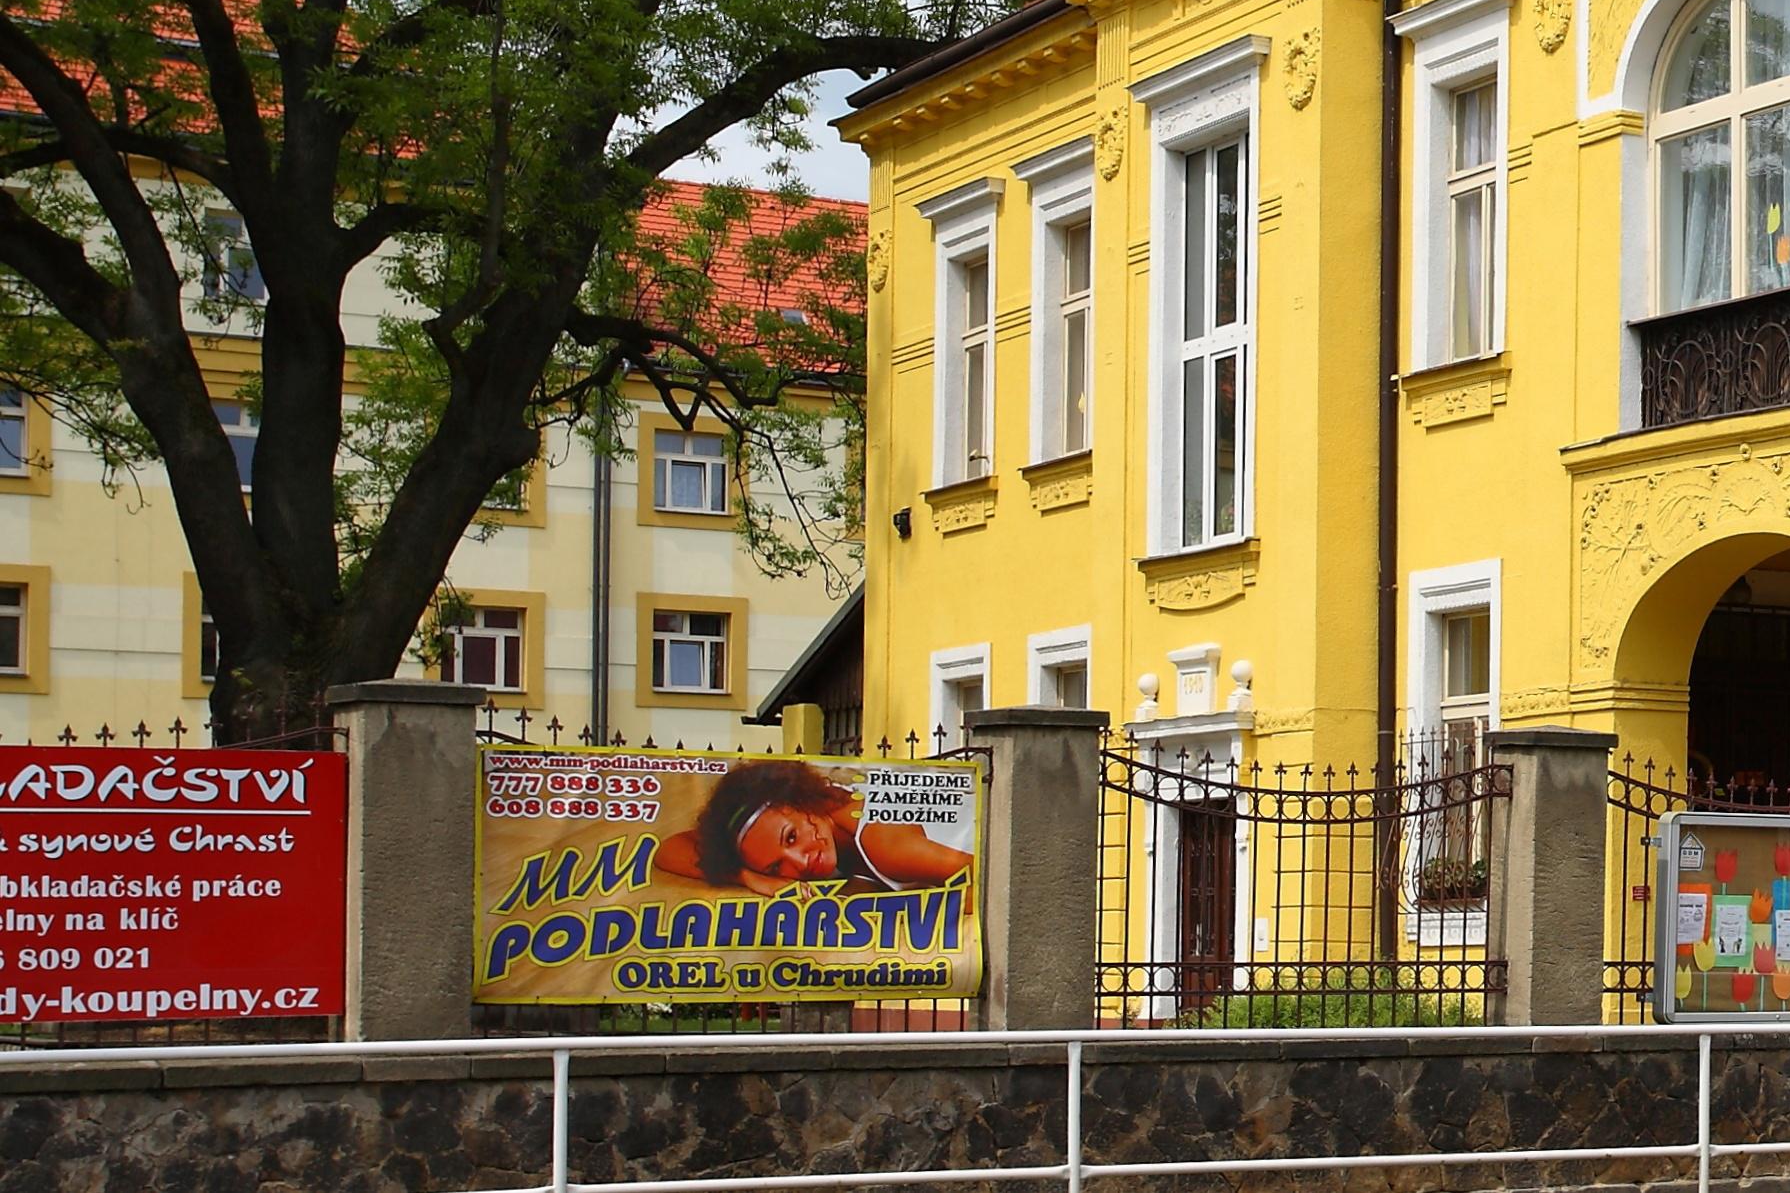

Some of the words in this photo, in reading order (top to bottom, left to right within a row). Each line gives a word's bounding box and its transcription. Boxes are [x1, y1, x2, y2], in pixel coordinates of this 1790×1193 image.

[487, 753, 727, 773] www.mm-podlaharstvi.cz
[0, 756, 315, 804] ADAČSTVÍ
[488, 774, 542, 794] 777
[548, 774, 601, 793] 888
[606, 776, 659, 795] 336
[868, 770, 971, 788] PŘIJEDEME
[488, 797, 541, 817] 608
[548, 798, 600, 817] 888
[605, 801, 659, 821] 337
[867, 789, 964, 806] ZAMĚŘÍME
[867, 807, 958, 824] POLOŽÍME
[18, 827, 156, 859] synové
[169, 824, 295, 852] Chrast
[493, 834, 658, 913] MM
[0, 874, 182, 898] bkladačské
[192, 874, 282, 902] práce
[0, 908, 55, 936] lny
[65, 913, 105, 931] na
[120, 907, 179, 930] klíč
[484, 869, 969, 982] PODLAHÁŘSTVÍ
[18, 947, 81, 970] 809
[94, 947, 149, 969] 021
[617, 960, 727, 989] OREL
[736, 967, 762, 988] u
[770, 961, 949, 989] Chrudimi
